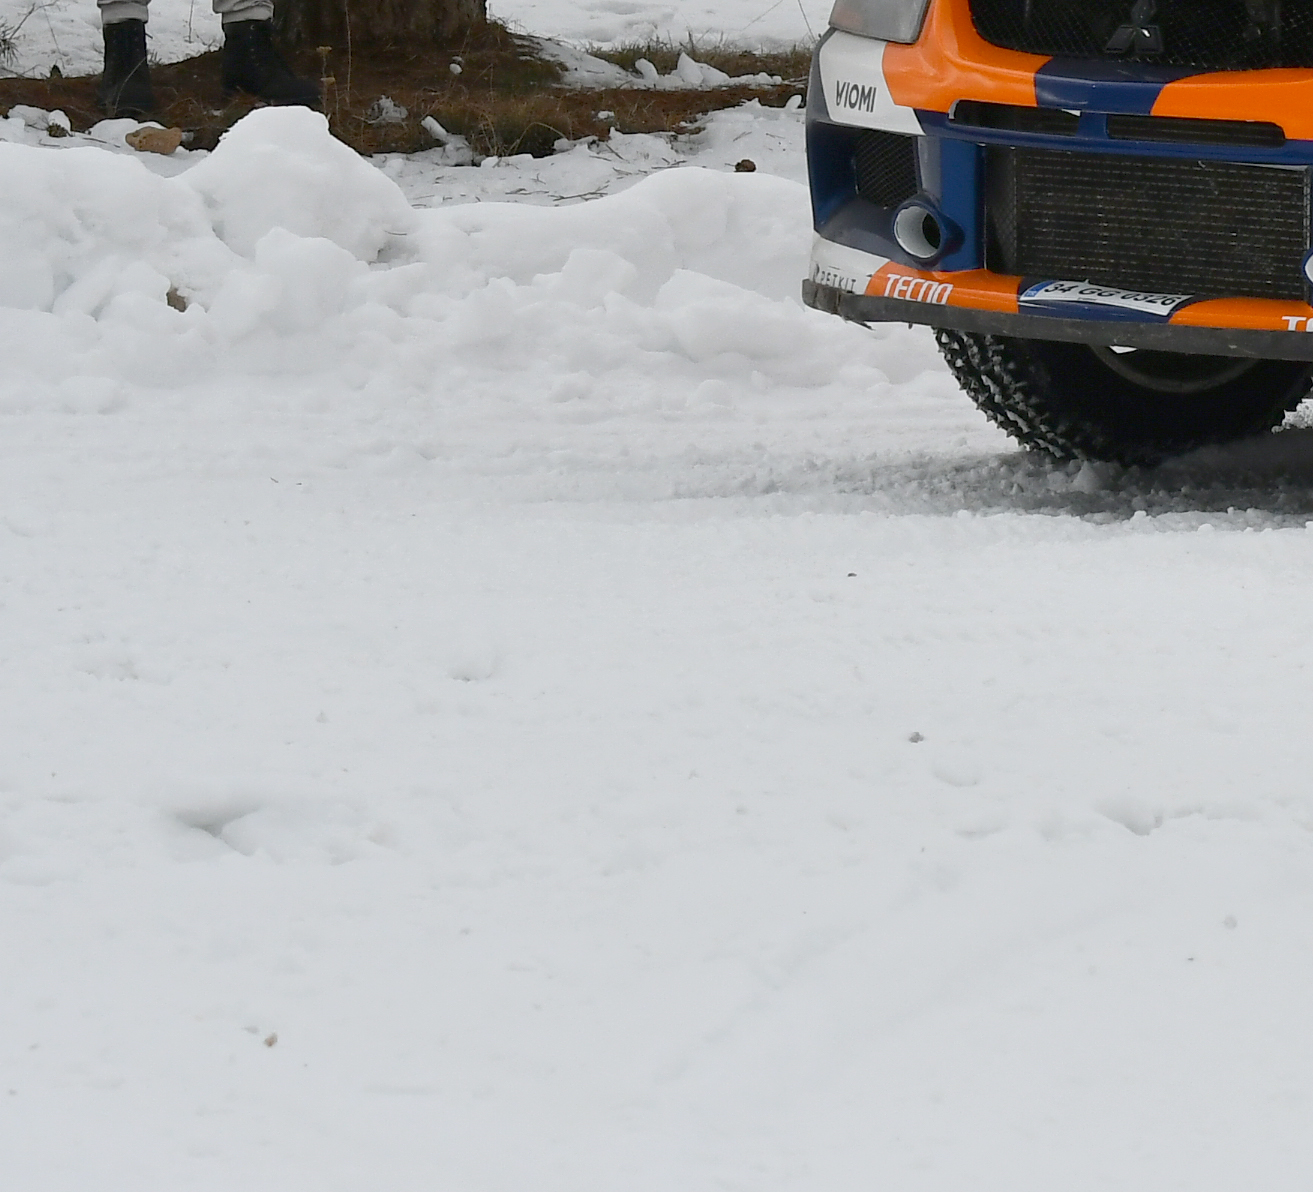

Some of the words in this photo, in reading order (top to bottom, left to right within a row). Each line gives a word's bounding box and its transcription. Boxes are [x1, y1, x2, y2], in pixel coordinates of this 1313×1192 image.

[834, 79, 878, 113] VIOMI
[884, 273, 954, 305] TECNO
[1043, 283, 1075, 294] 34
